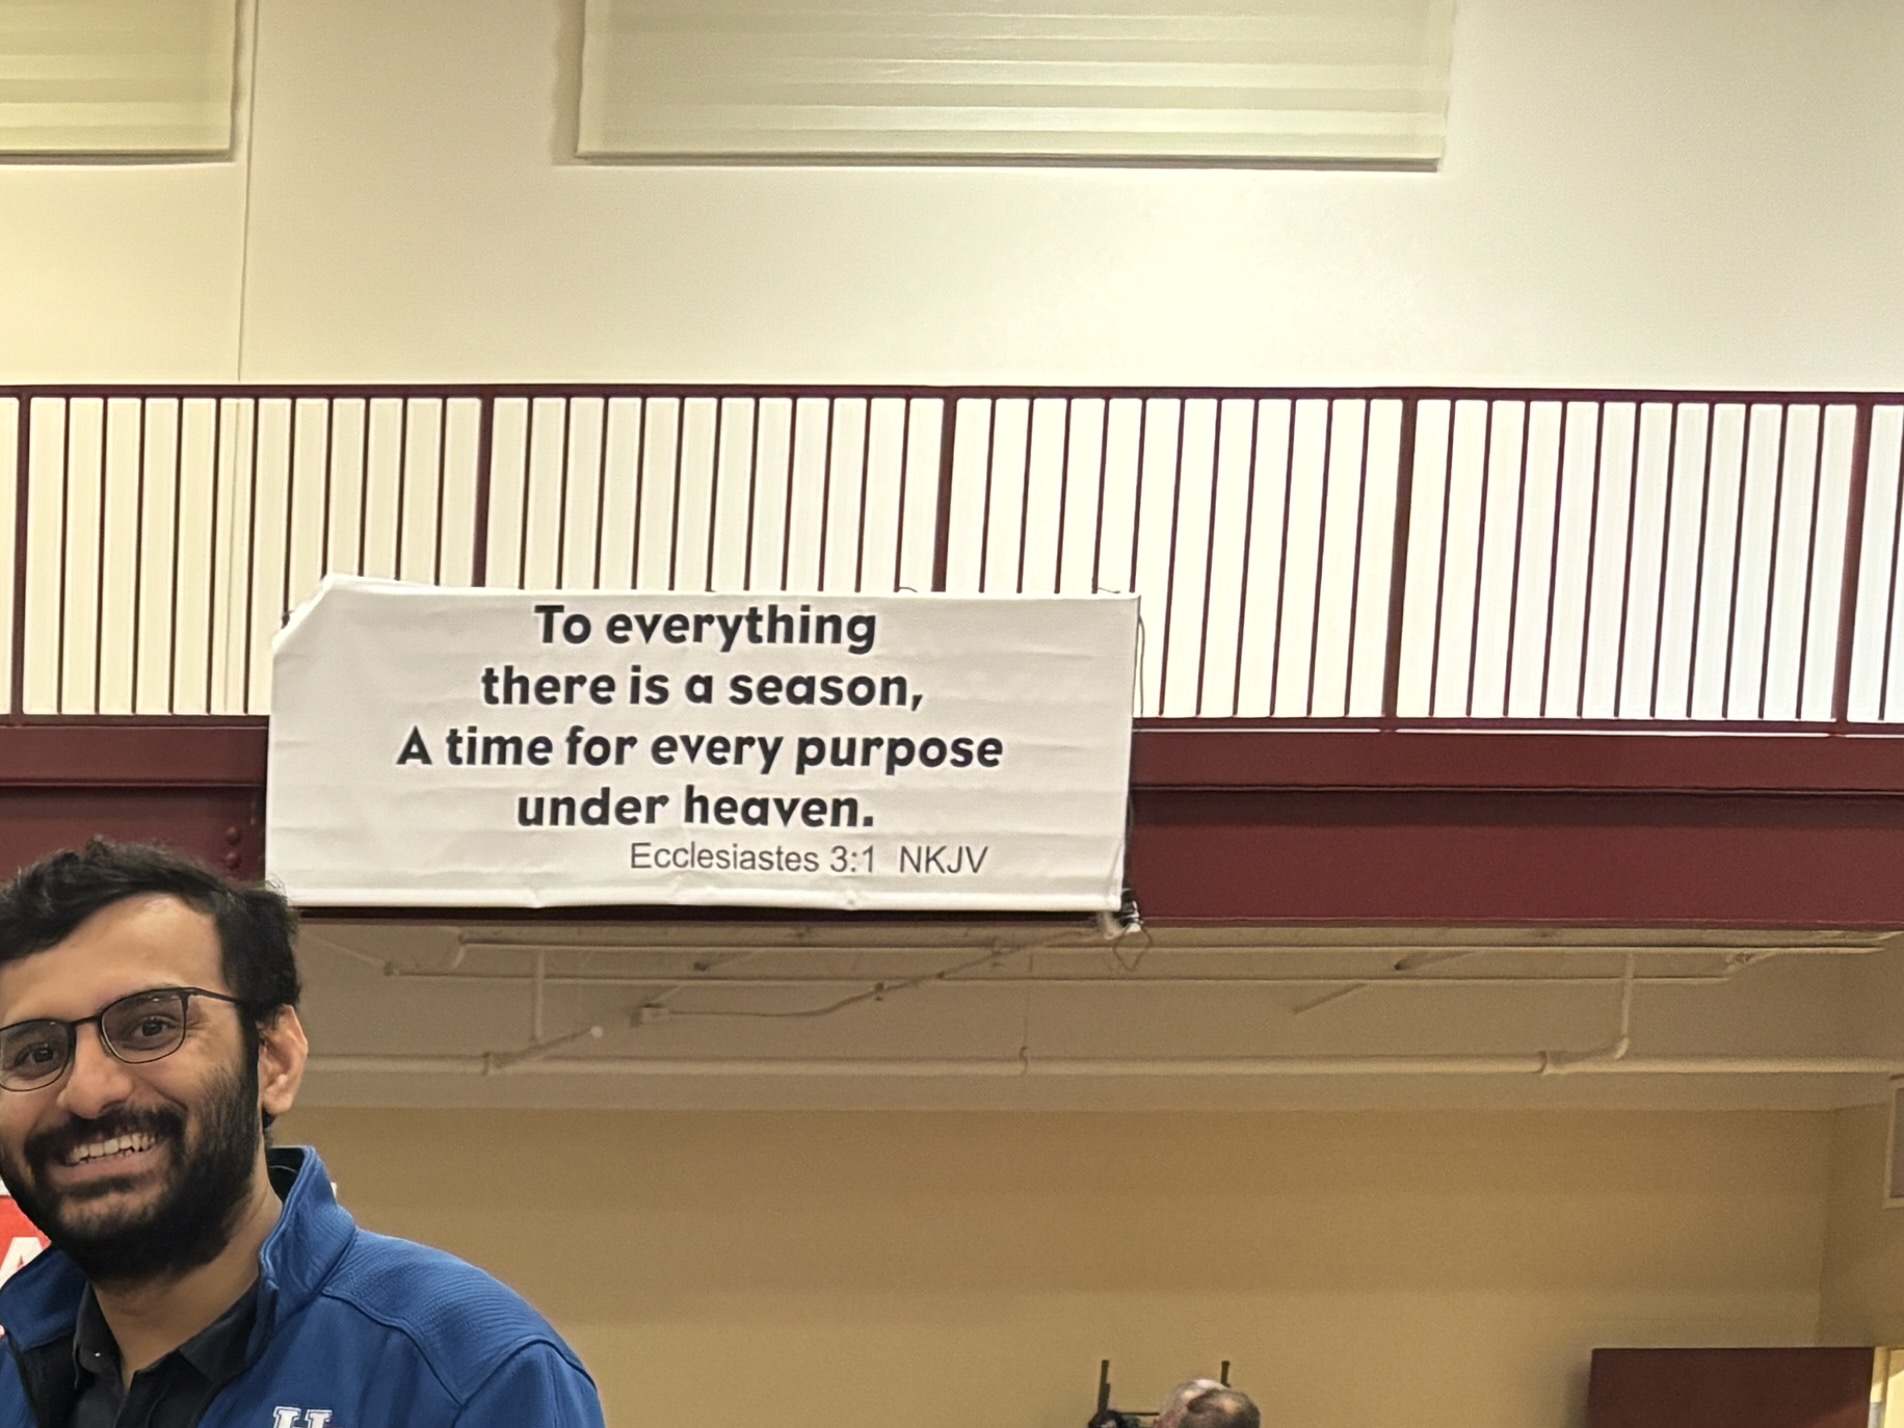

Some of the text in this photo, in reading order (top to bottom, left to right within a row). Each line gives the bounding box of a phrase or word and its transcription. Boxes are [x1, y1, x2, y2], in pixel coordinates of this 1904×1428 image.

[534, 604, 876, 655] To everything
[481, 664, 923, 712] there is a season,
[396, 725, 1003, 776] A time for every purpose
[517, 784, 874, 828] under heaven.
[630, 840, 989, 874] Ecclesiastes 3:1 NKJV
